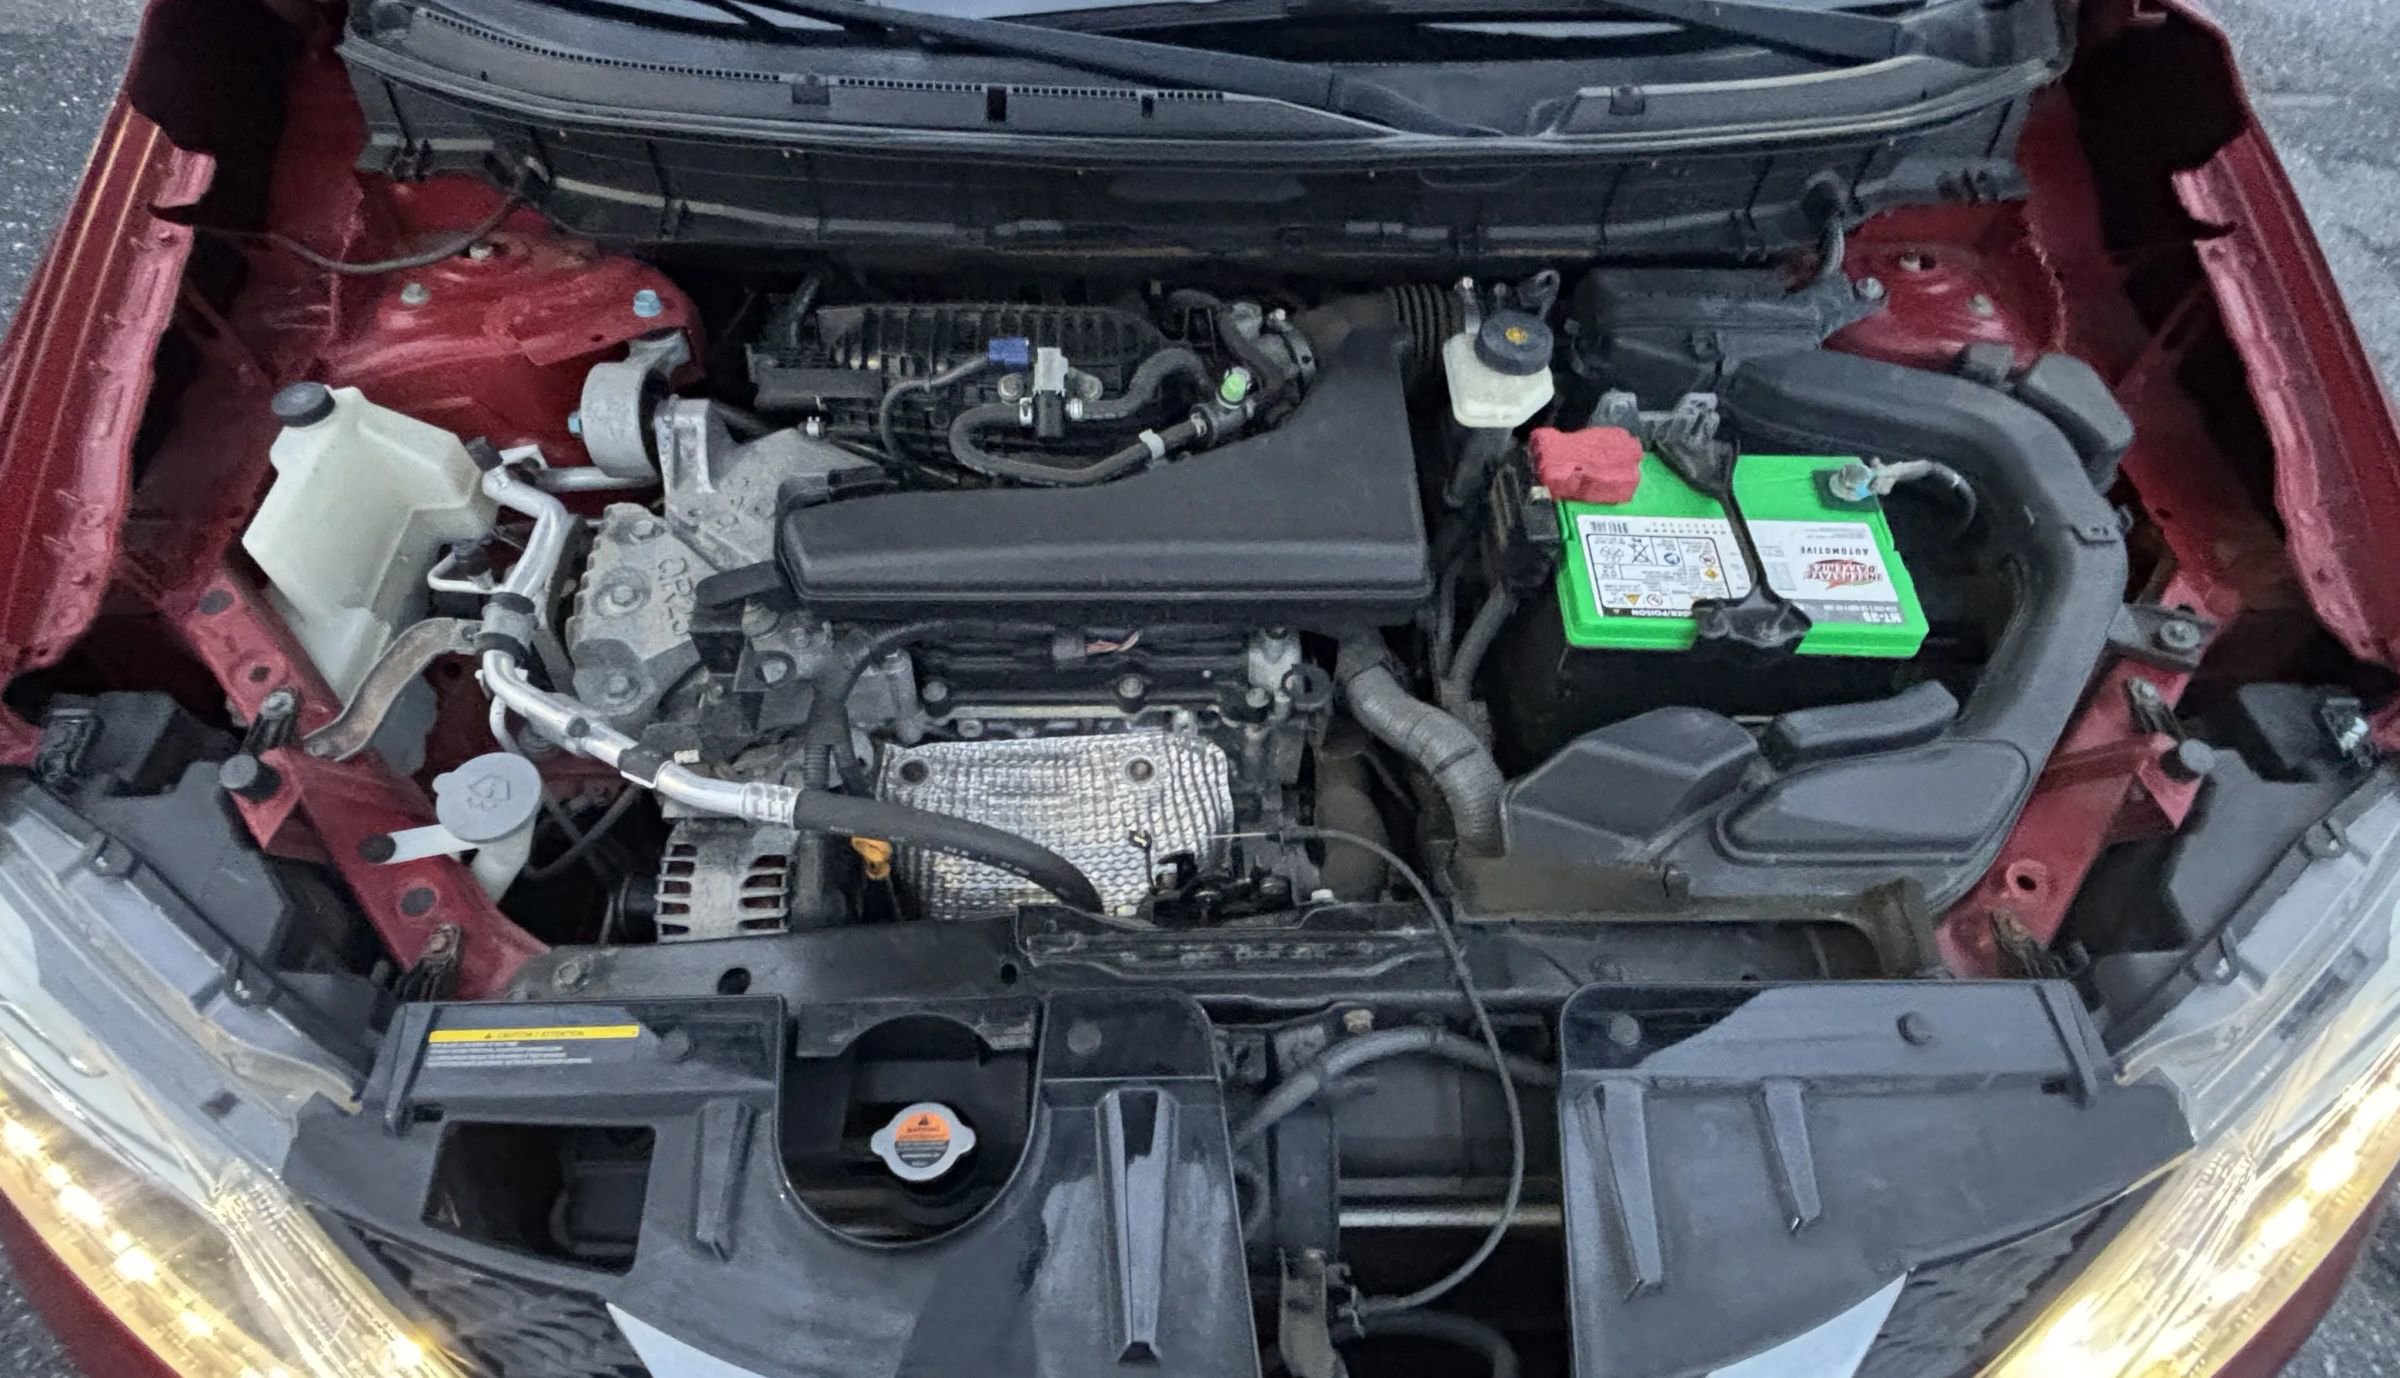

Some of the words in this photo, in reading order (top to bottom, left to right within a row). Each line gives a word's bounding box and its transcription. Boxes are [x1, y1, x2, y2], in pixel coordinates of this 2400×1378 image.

[1801, 546, 1869, 556] AUTOMOTIVE
[1807, 563, 1877, 573] BATTERIES
[1804, 571, 1883, 581] INTERSTATE
